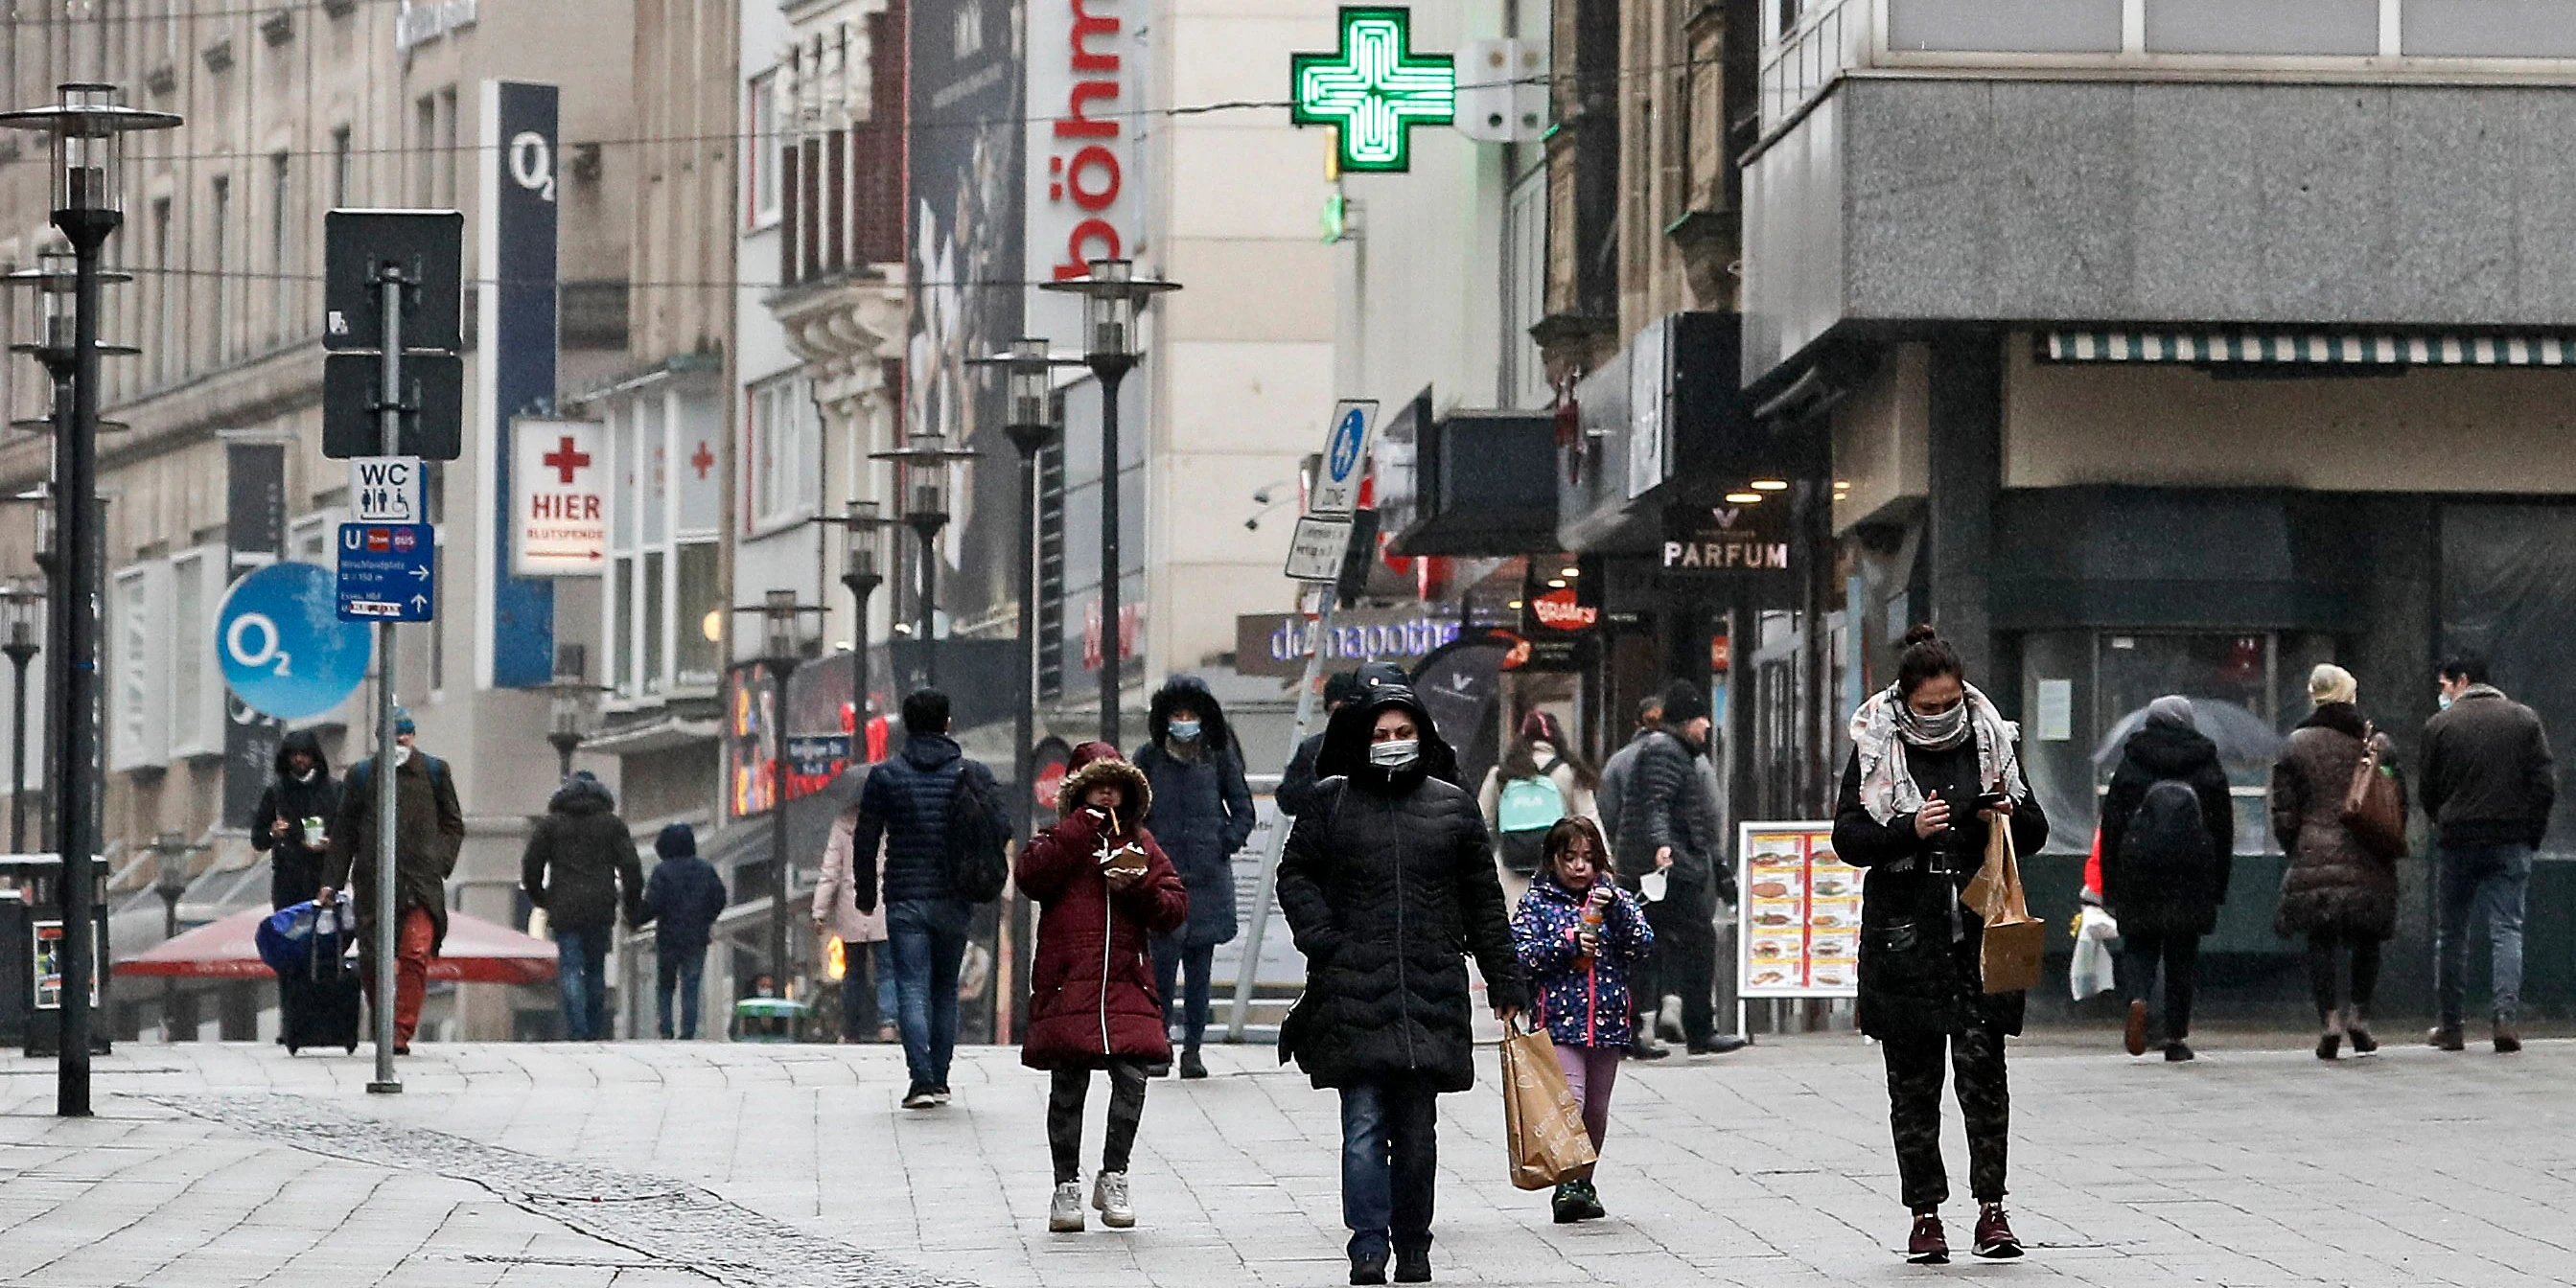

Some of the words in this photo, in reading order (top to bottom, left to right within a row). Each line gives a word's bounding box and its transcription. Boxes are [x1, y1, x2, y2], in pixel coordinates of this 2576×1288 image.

[360, 464, 408, 486] WC
[532, 494, 601, 518] HIER
[345, 530, 361, 550] U
[1663, 541, 1788, 568] PARFUM
